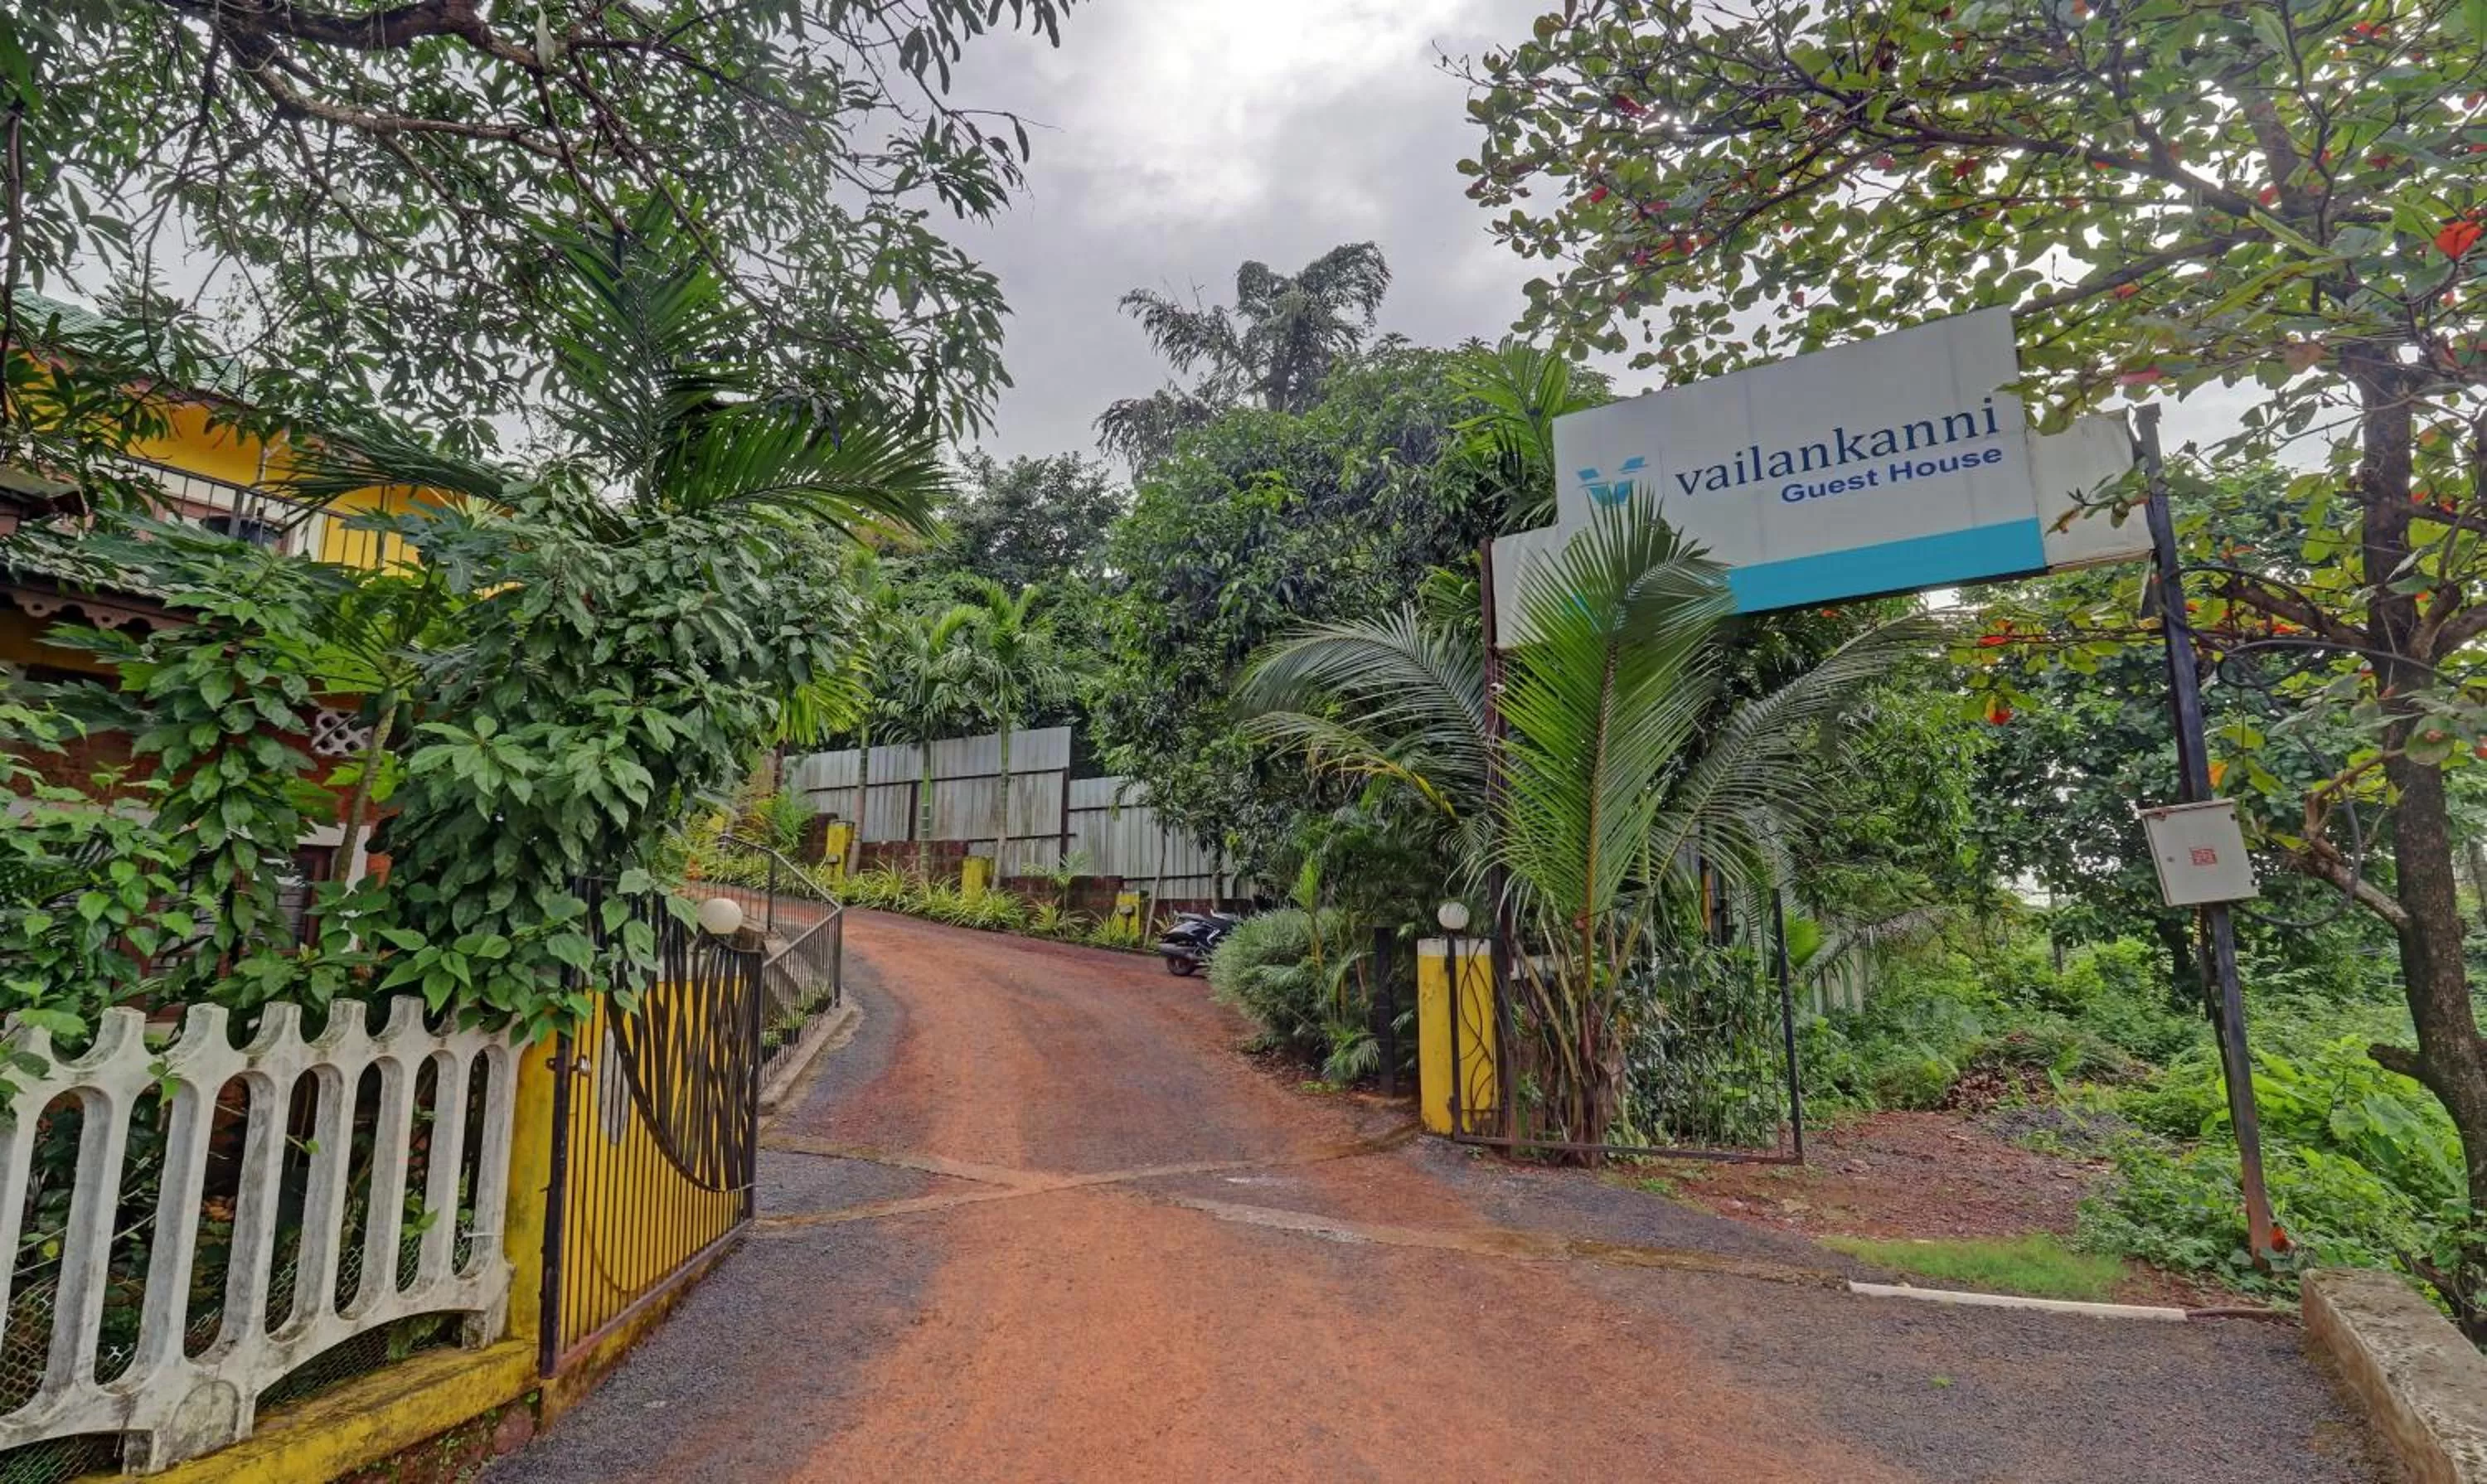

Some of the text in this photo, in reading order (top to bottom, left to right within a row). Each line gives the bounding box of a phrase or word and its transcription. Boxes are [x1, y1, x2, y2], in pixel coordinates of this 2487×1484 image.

[1675, 397, 2000, 497] vailankanni
[1782, 448, 2002, 502] Guest House
